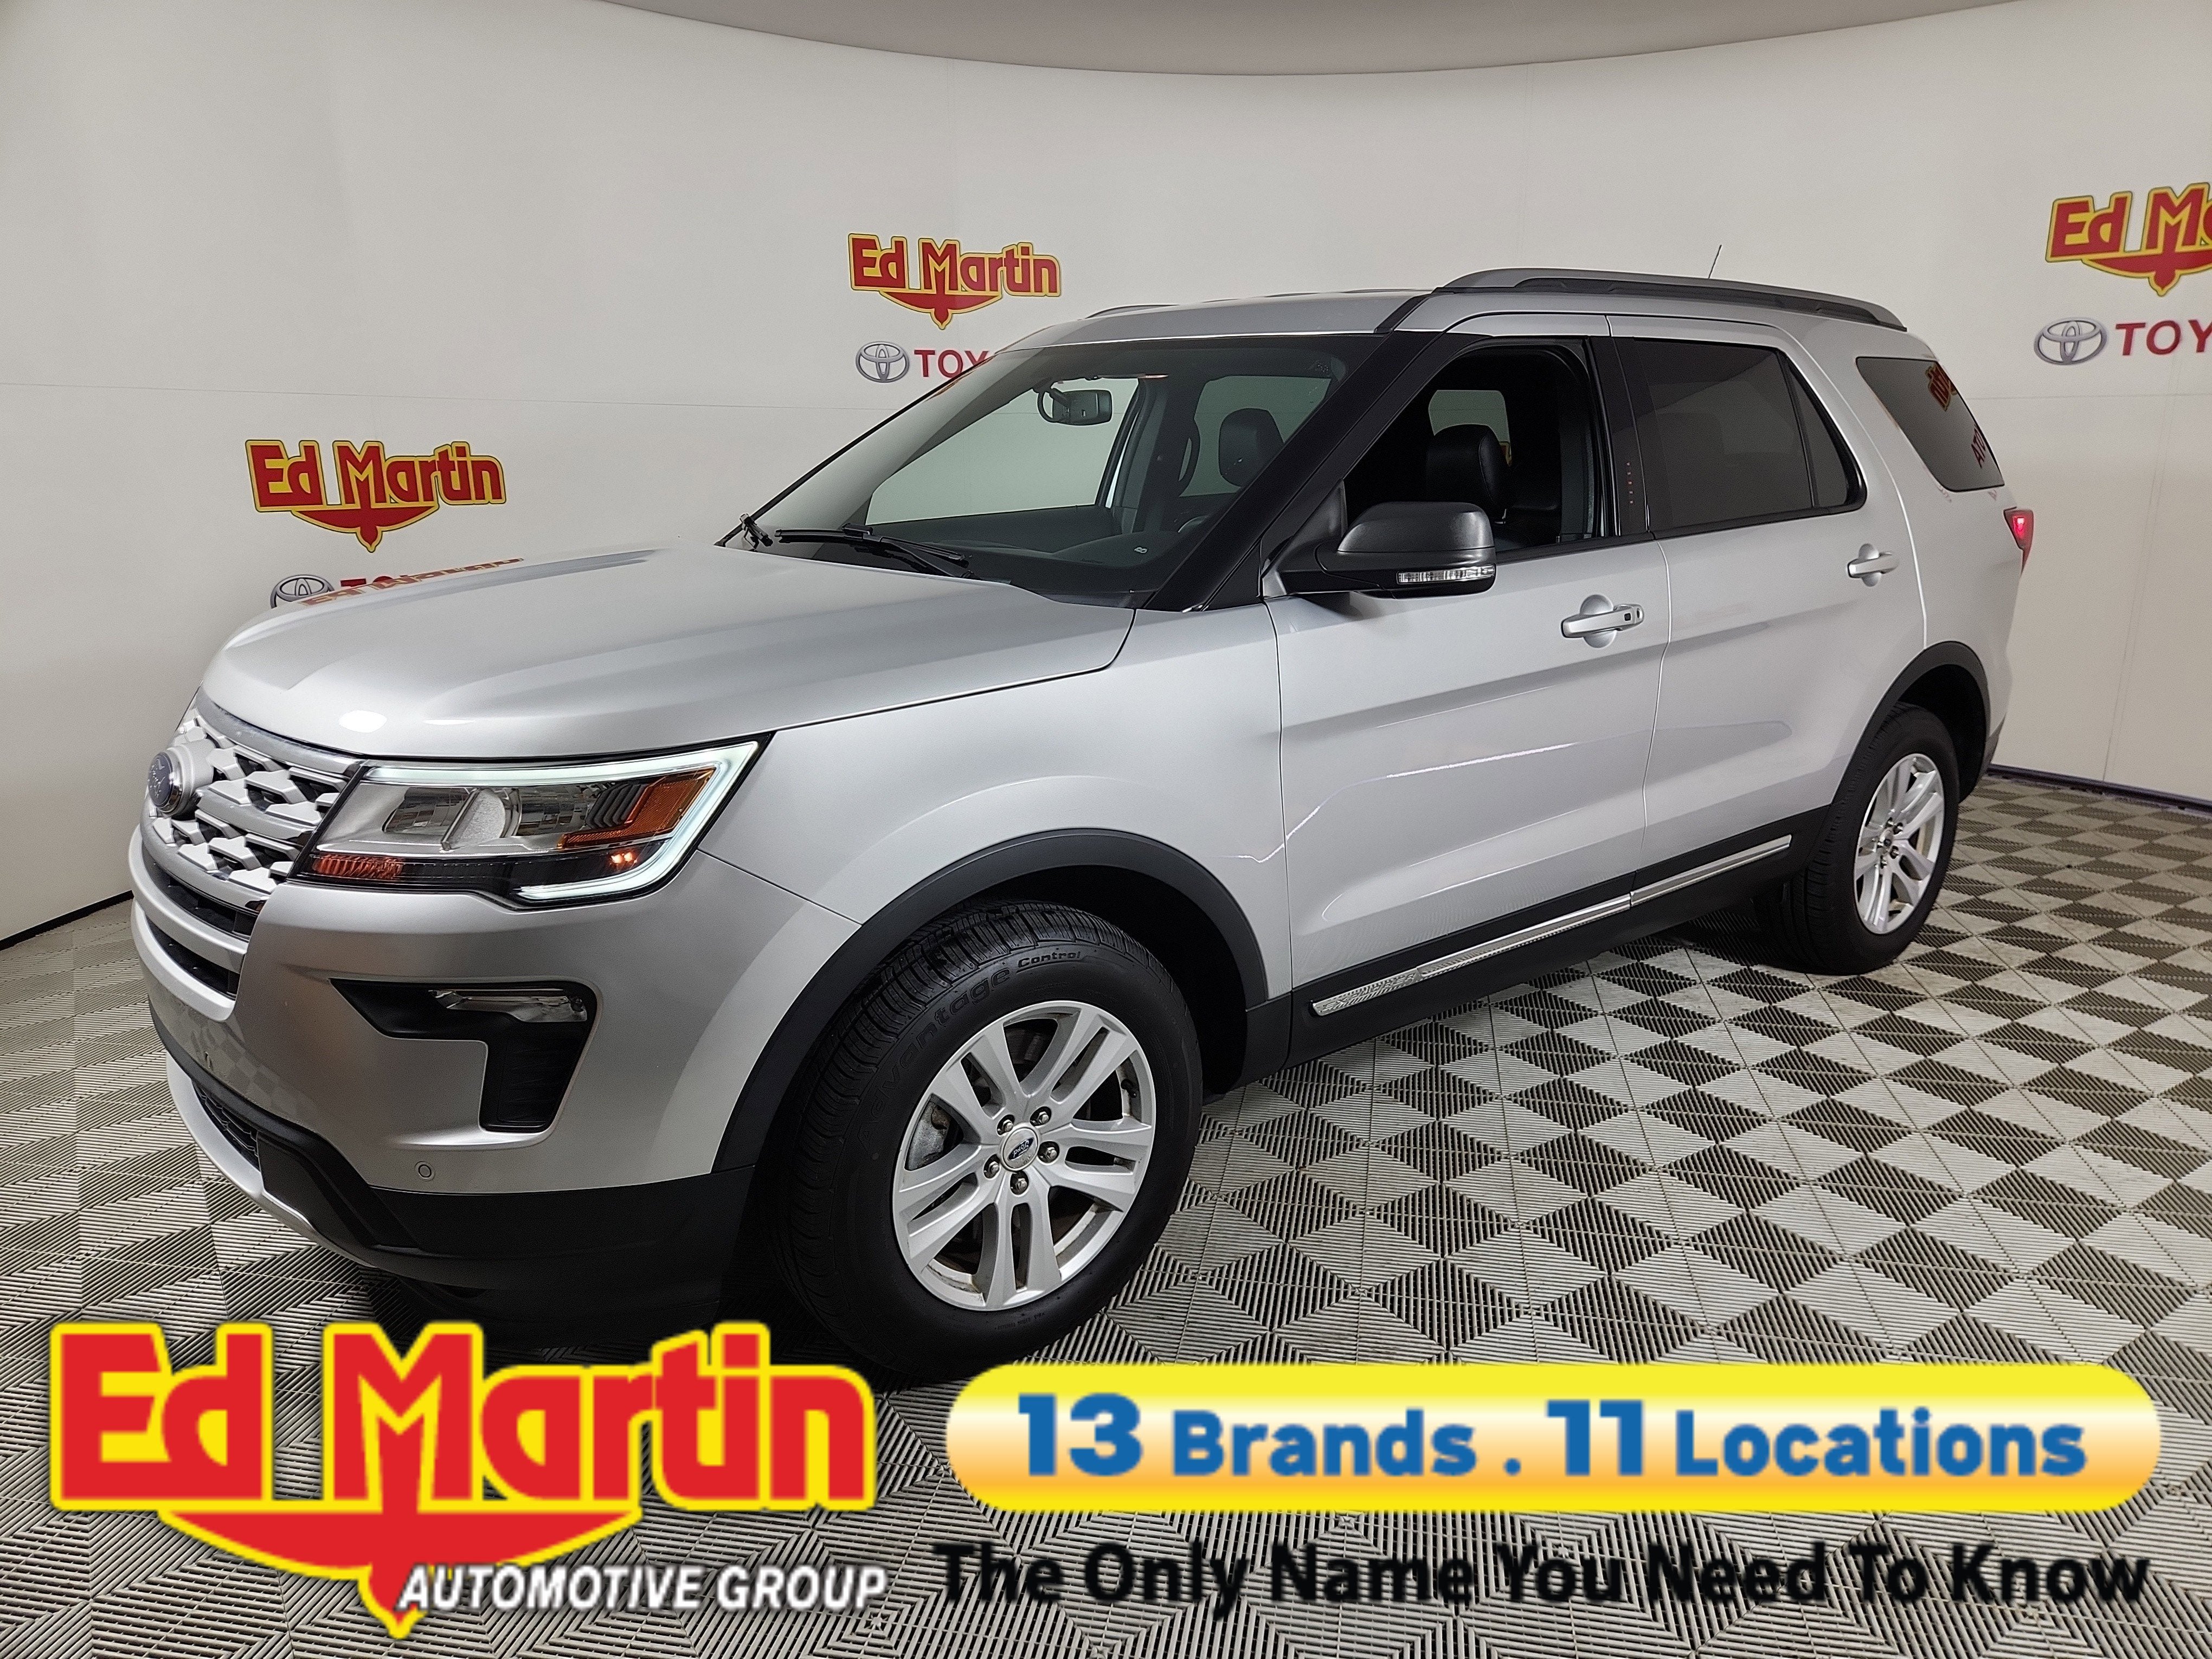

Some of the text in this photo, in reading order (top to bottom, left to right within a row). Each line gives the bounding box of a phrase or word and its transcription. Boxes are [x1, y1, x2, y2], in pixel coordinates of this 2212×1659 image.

[2051, 195, 2128, 258] Ed
[851, 236, 1059, 294] Ed Martin
[250, 444, 504, 508] Ed Martin
[1018, 951, 1081, 968] Control
